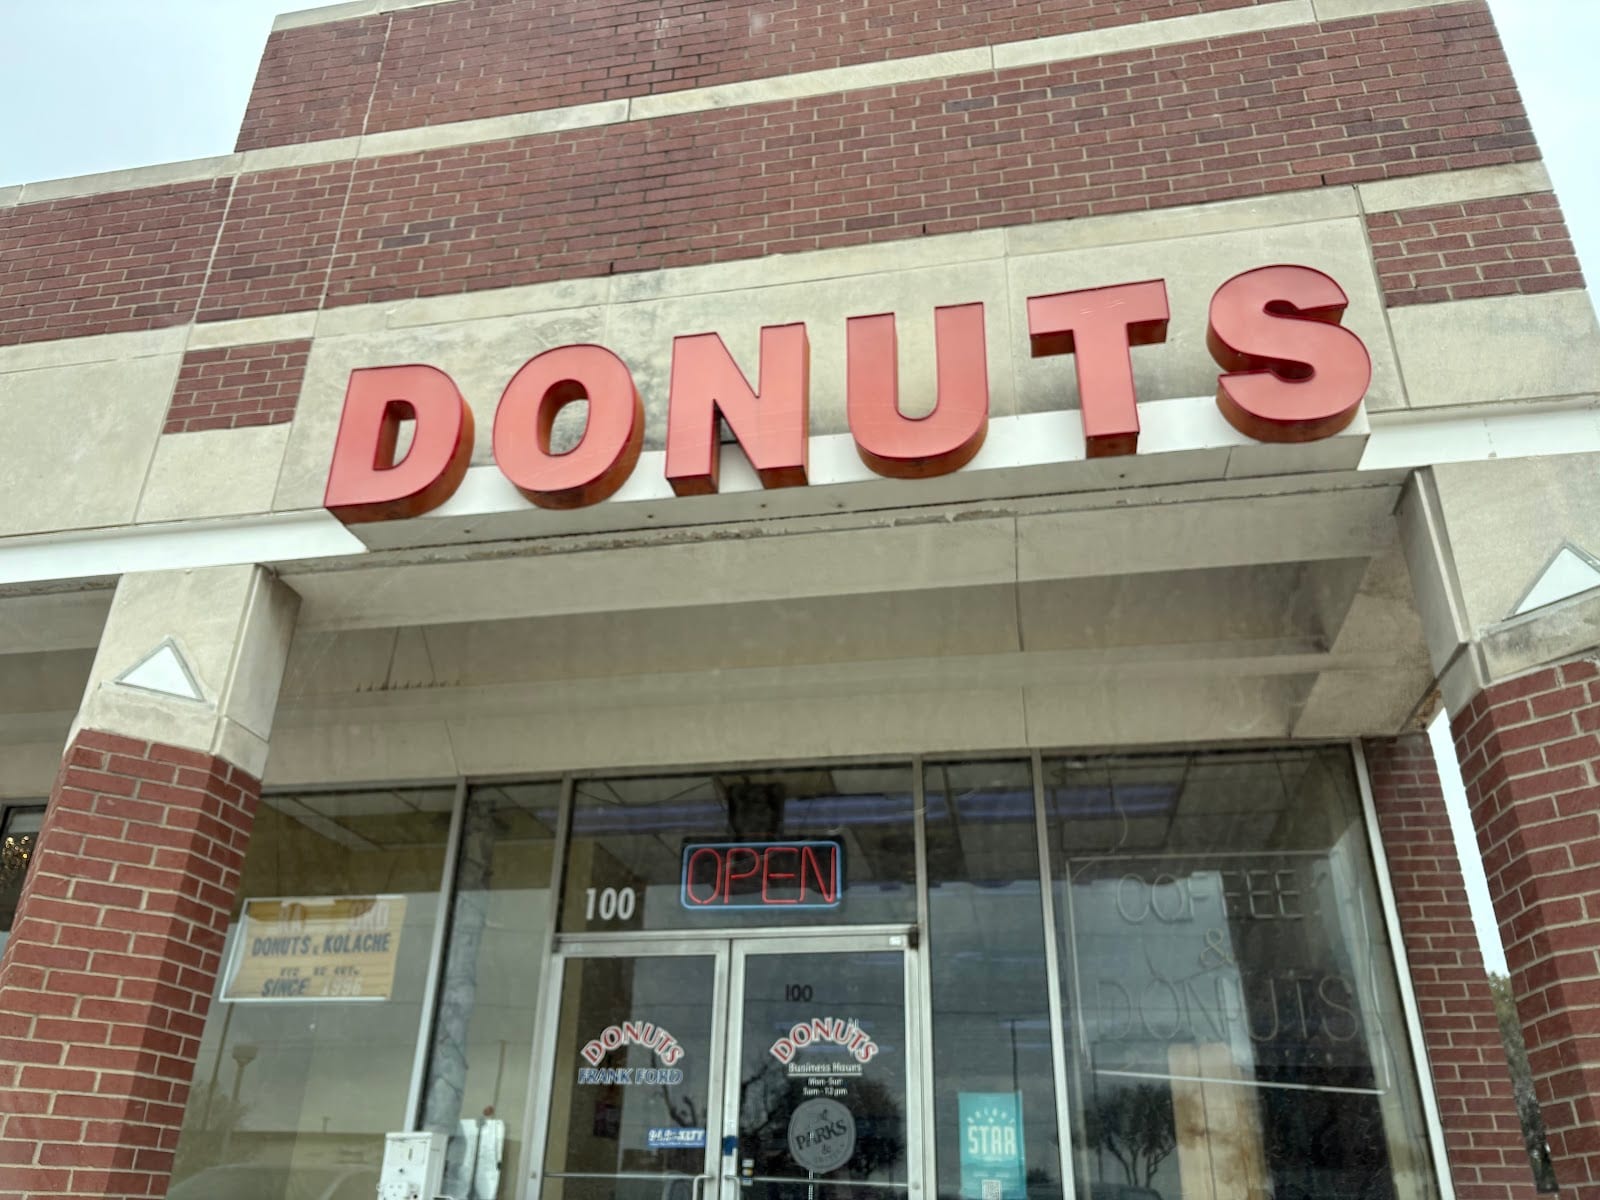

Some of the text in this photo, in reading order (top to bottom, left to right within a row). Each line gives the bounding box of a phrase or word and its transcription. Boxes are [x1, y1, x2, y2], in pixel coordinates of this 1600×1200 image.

[325, 264, 1371, 518] DONUTS
[687, 847, 837, 904] OPEN
[585, 887, 635, 920] 100
[252, 935, 312, 957] DONUTS
[322, 931, 392, 953] KOLACHE
[1200, 928, 1235, 968] &
[261, 977, 310, 997] SINCE
[785, 984, 813, 1001] 100
[1097, 974, 1358, 1042] DONUTS
[581, 1021, 685, 1066] DONUTS
[770, 1017, 879, 1064] DONUTS
[788, 1061, 862, 1073] Business Hours
[795, 1119, 848, 1151] PARKS
[967, 1125, 1017, 1155] STAR
